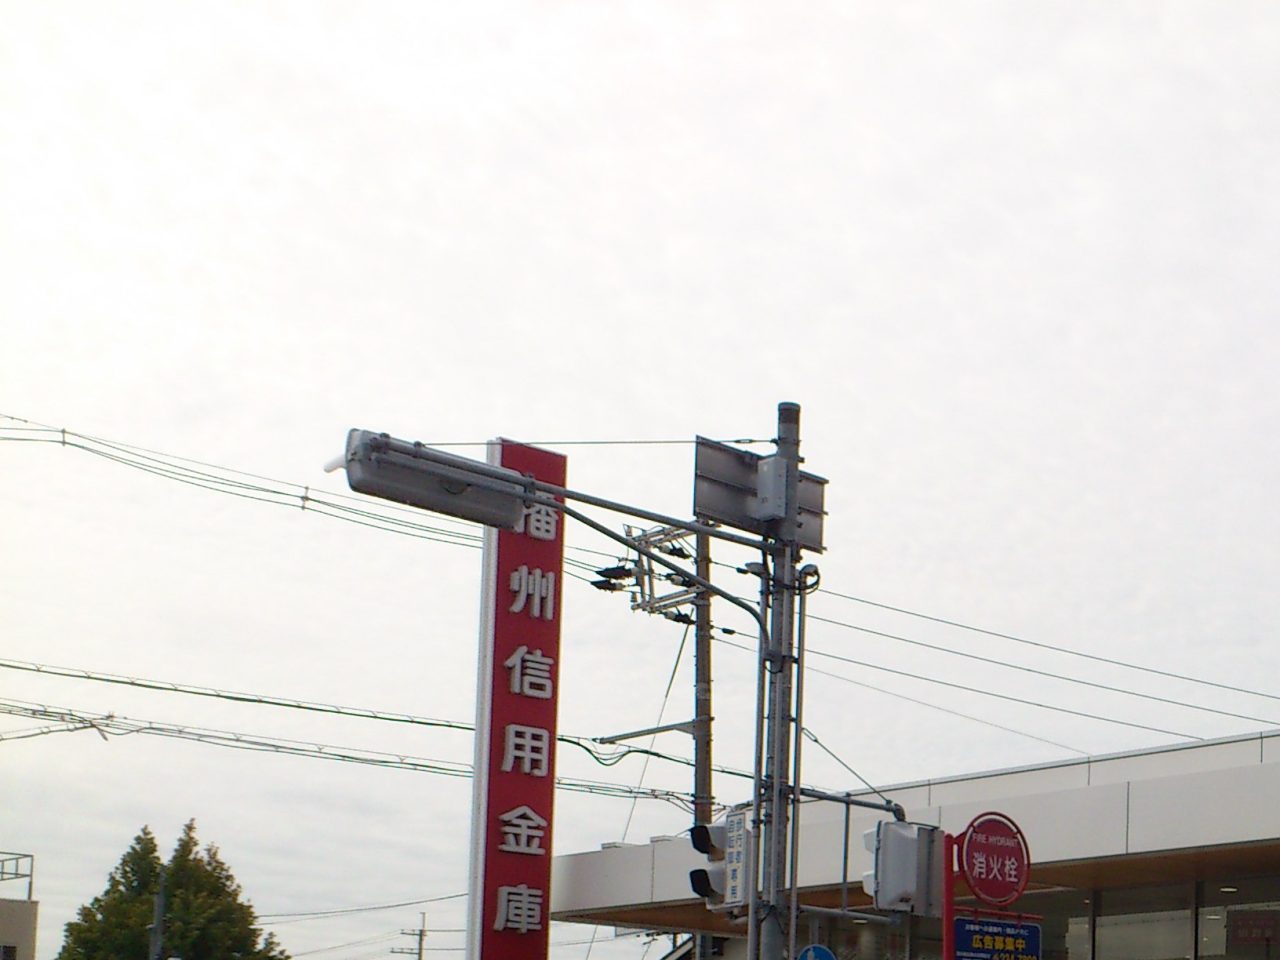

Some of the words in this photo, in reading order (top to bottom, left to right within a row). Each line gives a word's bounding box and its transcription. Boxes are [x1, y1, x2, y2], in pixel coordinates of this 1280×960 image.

[972, 832, 987, 844] FIRE
[972, 851, 1018, 882] 消火栓
[972, 934, 1026, 951] 広告募集中
